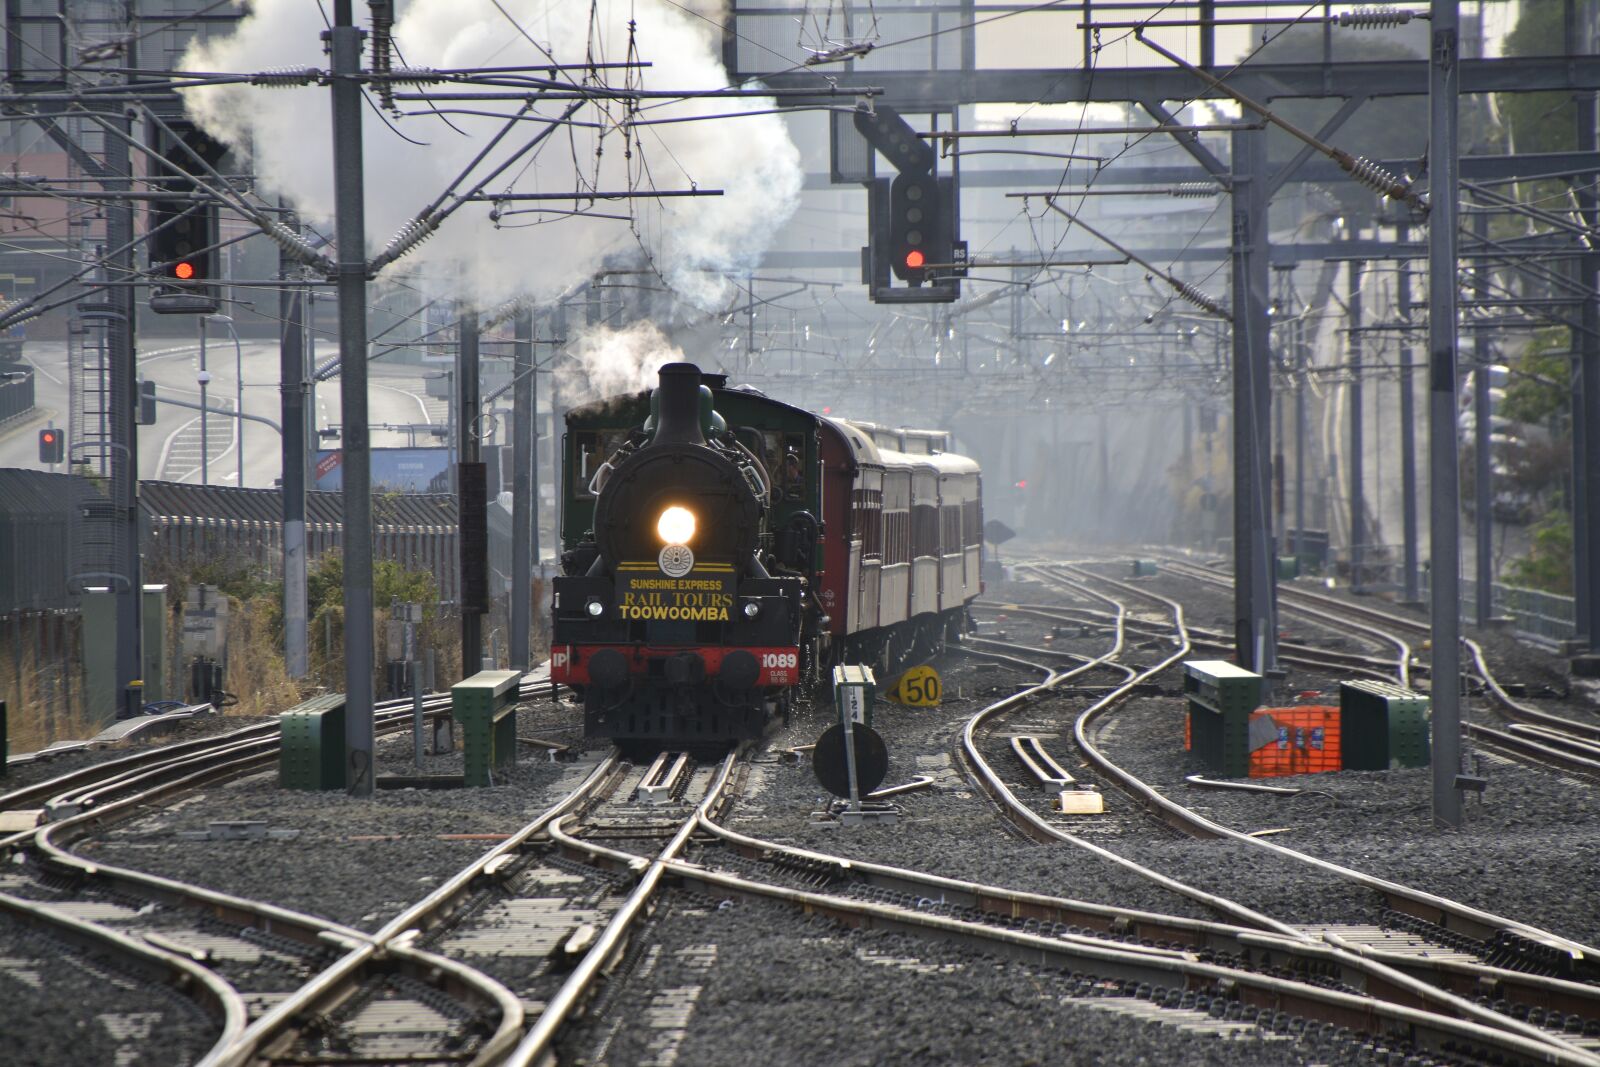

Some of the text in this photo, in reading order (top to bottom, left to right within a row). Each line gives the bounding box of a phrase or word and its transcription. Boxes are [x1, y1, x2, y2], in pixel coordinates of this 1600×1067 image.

[953, 249, 965, 259] RS
[630, 579, 722, 591] SUNSHINE EXPRESS
[624, 592, 733, 607] RAIL TOURS
[619, 605, 729, 621] TOOWOOMBA
[762, 653, 797, 669] 1089
[907, 676, 938, 702] 50
